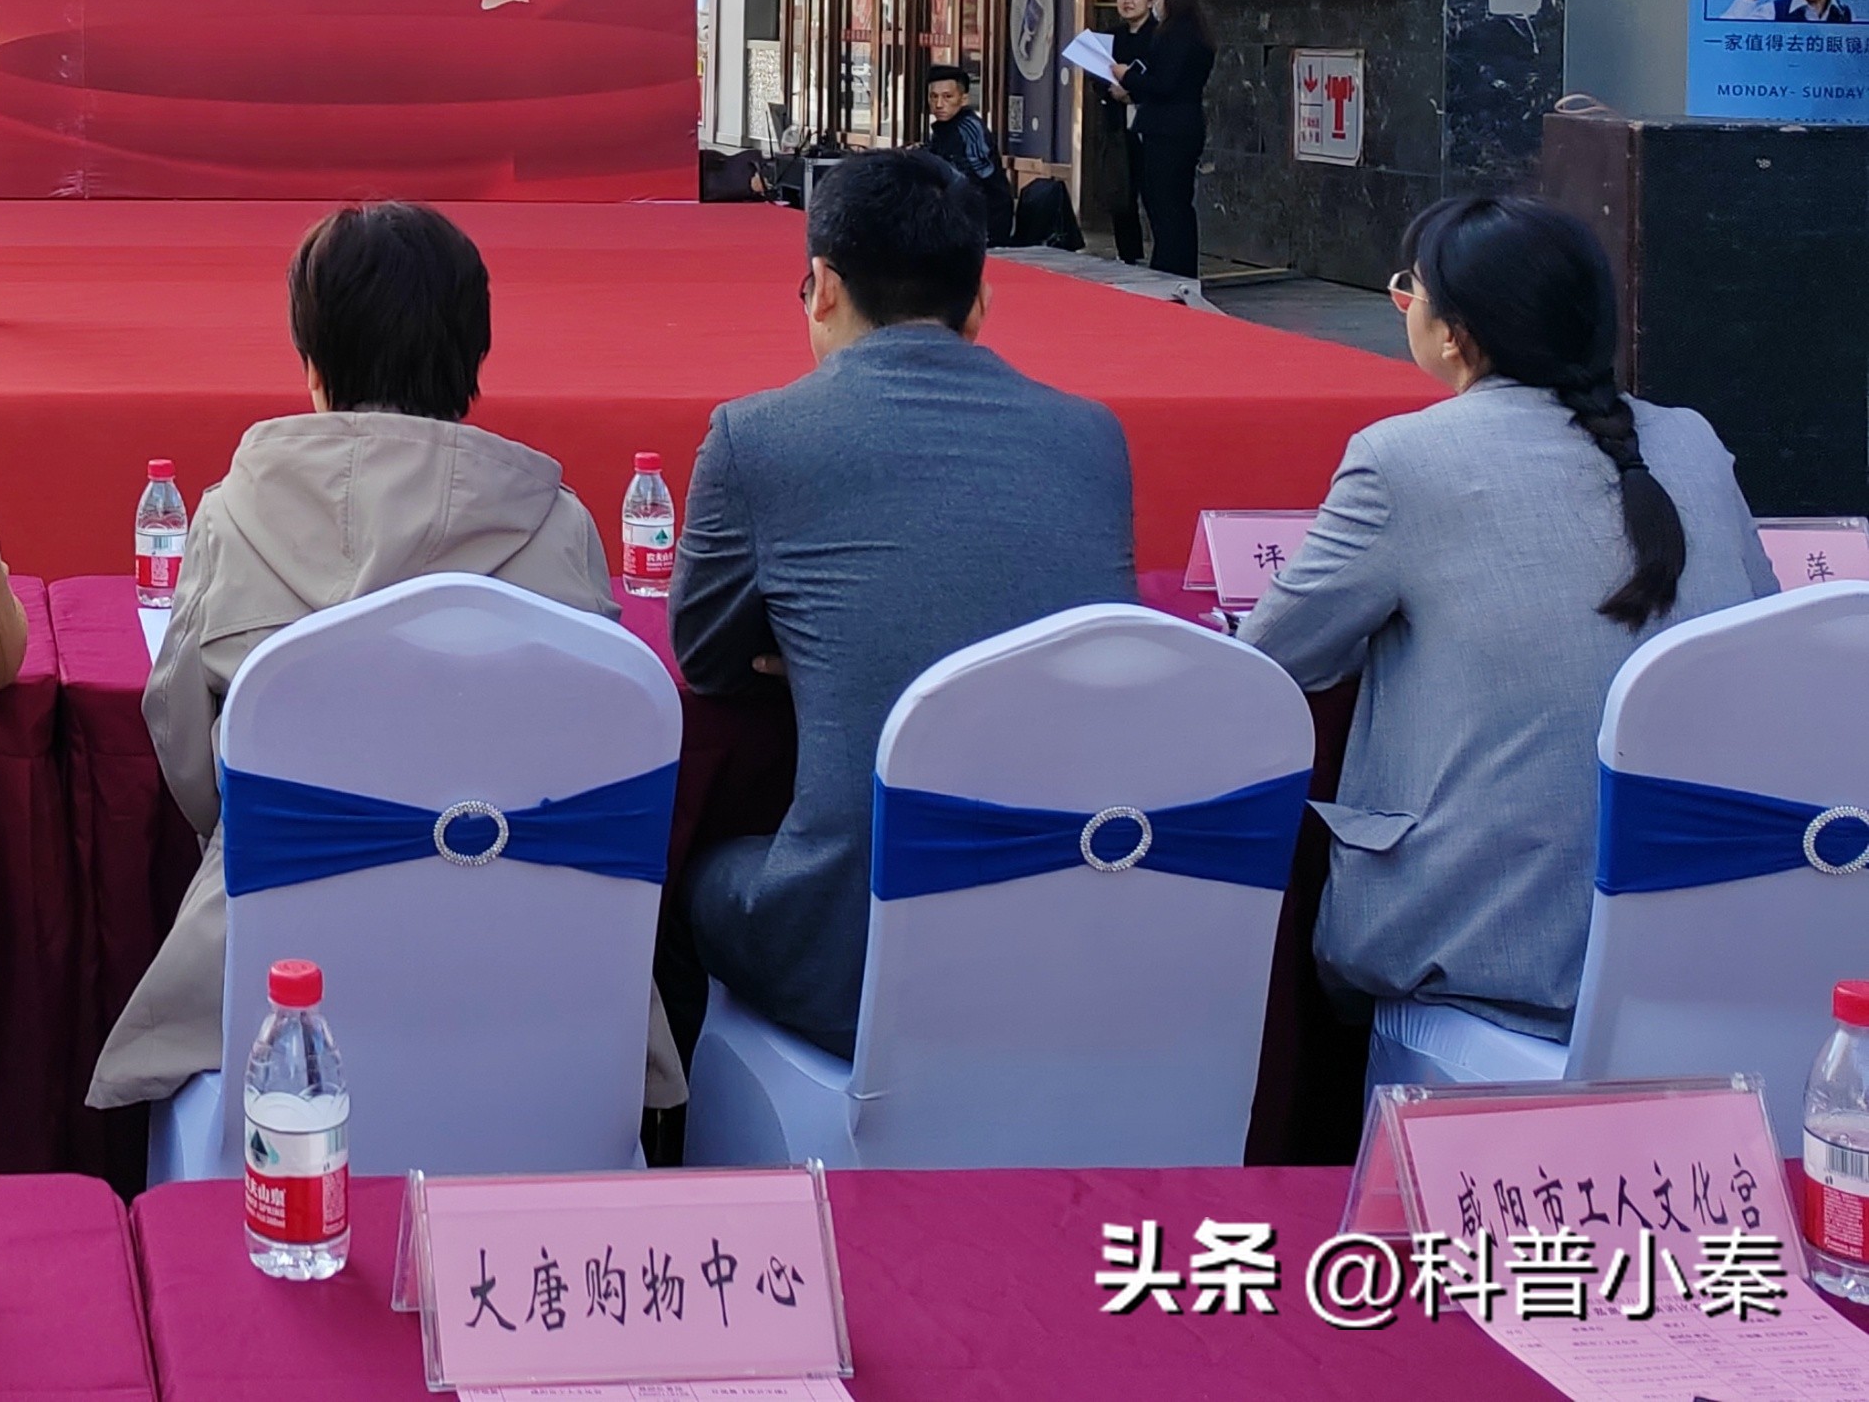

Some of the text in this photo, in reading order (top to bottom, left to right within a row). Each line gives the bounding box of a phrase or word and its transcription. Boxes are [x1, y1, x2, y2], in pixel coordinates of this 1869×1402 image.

[1457, 1153, 1761, 1247] 咸阳市工人文化宫
[465, 1237, 806, 1332] 大唐购物中心
